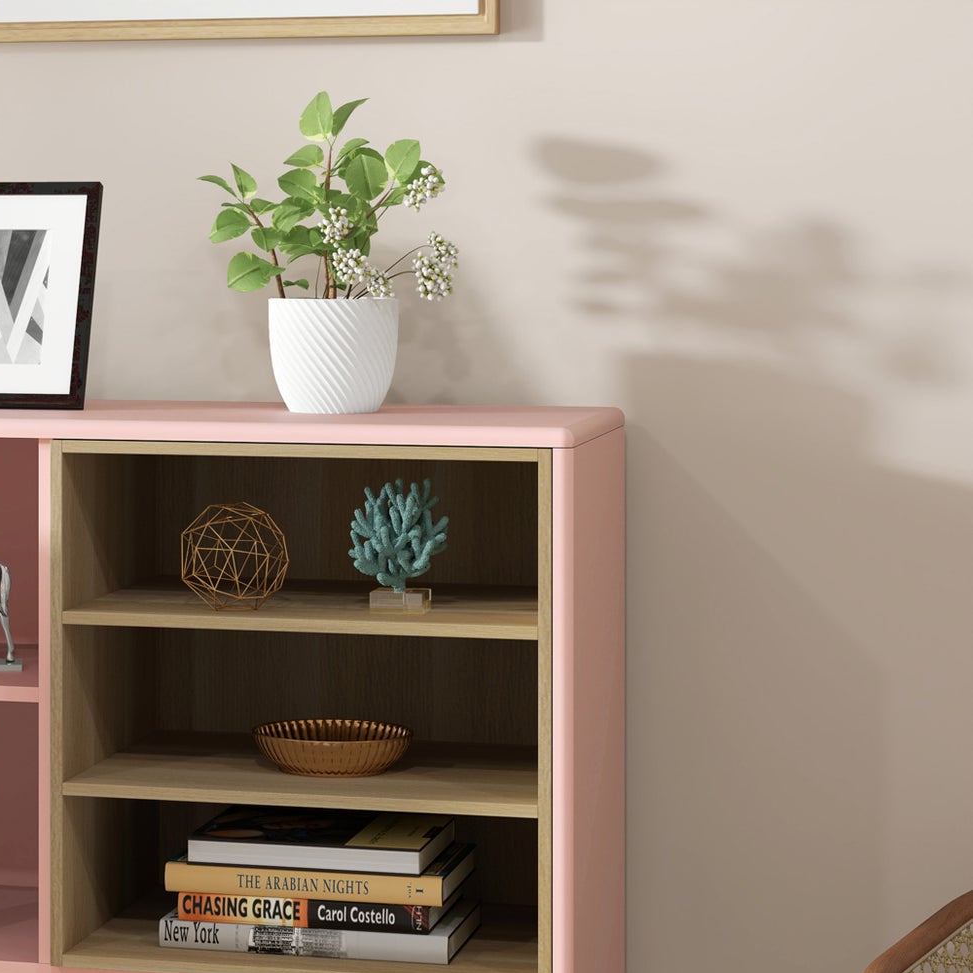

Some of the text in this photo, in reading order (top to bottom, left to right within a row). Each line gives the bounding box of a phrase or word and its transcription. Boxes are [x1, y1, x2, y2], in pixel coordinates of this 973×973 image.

[237, 874, 369, 896] THE ARABIAN NIGHTS
[182, 894, 396, 925] CHASING GRACE Carol Costello
[164, 920, 189, 943] New
[193, 922, 219, 945] York
